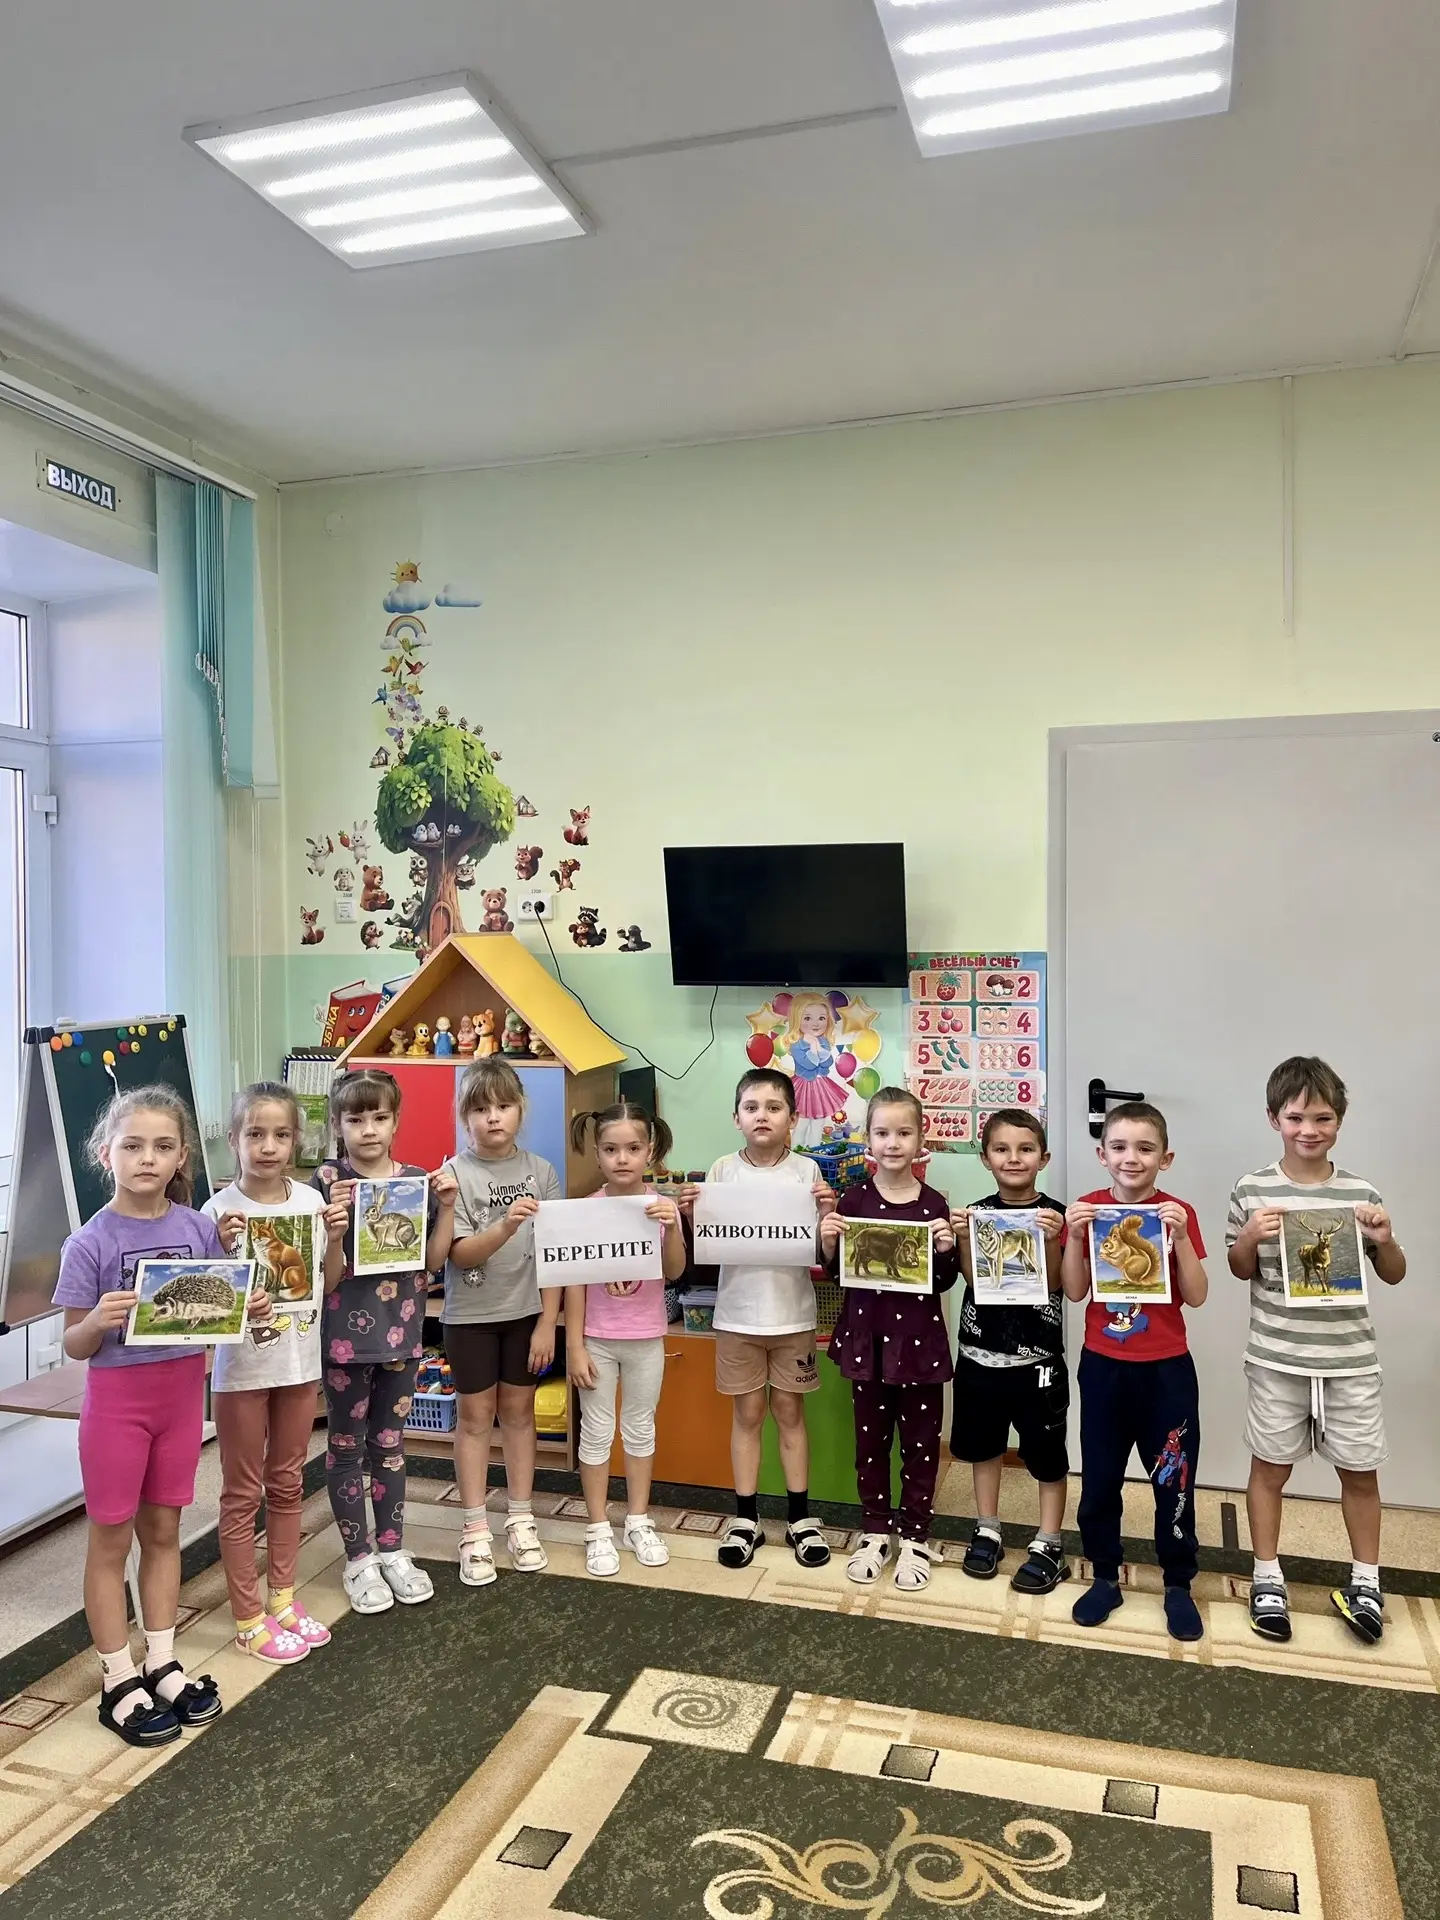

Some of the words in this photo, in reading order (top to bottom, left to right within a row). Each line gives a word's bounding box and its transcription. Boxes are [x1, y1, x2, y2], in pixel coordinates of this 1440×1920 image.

[48, 463, 113, 509] ВЫХОД
[929, 954, 987, 969] ВЕСЁЛЫЙ
[989, 955, 1020, 969] СЧЁТ
[919, 976, 927, 997] 1
[1017, 976, 1031, 997] 2
[323, 1006, 340, 1048] ЗБУКА
[918, 1011, 930, 1031] 3
[1017, 1012, 1031, 1032] 4
[918, 1044, 930, 1064] 5
[1017, 1046, 1031, 1067] 6
[918, 1079, 929, 1099] 7
[1017, 1081, 1031, 1102] 8
[696, 1224, 812, 1239] ЖИВОТНЫХ
[543, 1240, 654, 1263] БЕРЕГИТЕ
